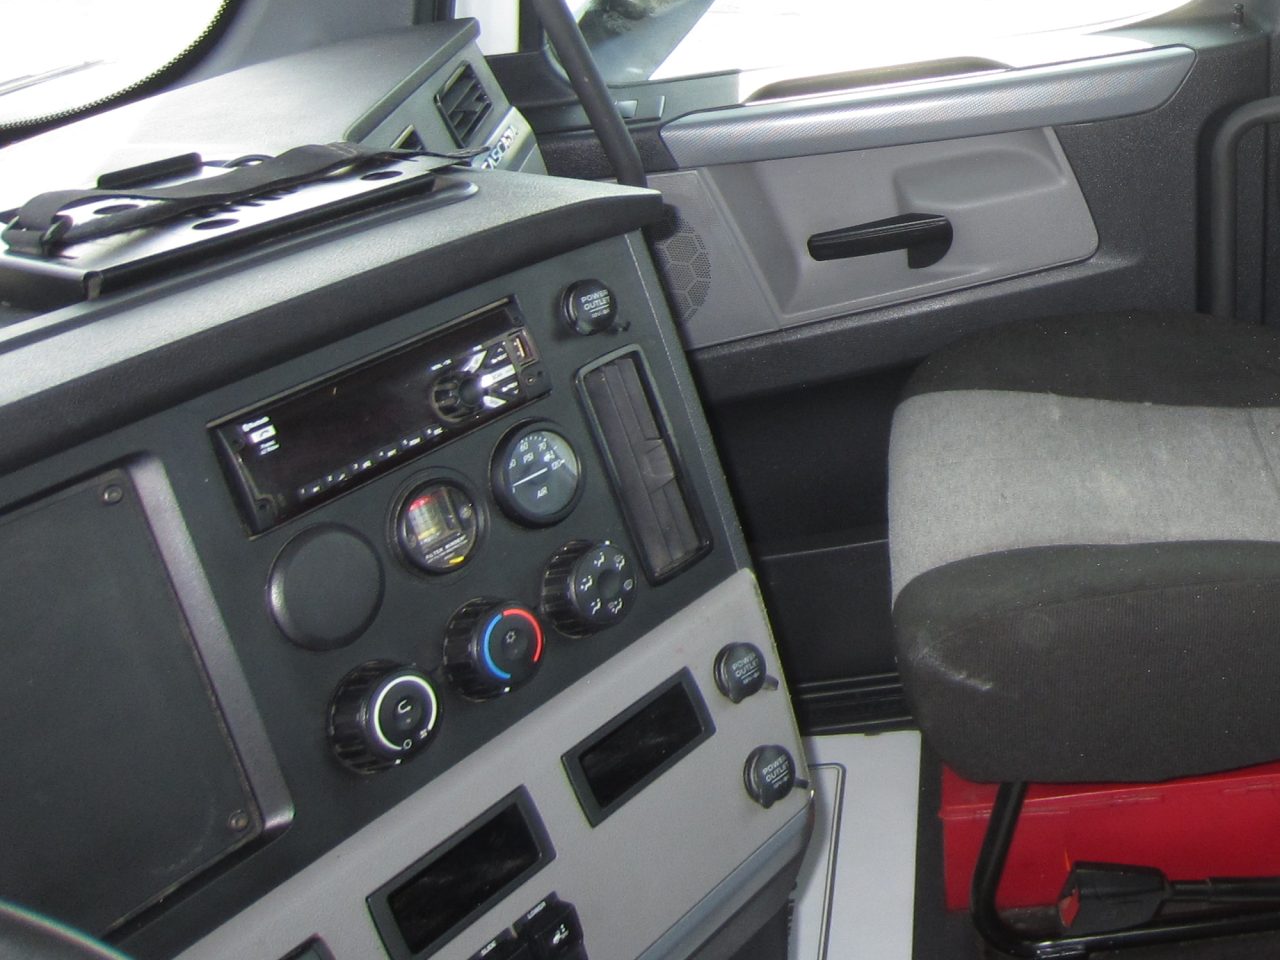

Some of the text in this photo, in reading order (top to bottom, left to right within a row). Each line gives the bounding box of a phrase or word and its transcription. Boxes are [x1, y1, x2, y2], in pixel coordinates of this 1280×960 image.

[581, 289, 609, 303] POWER
[583, 295, 610, 310] OUTLET
[735, 658, 760, 678] OUTLET
[765, 760, 790, 783] OUTLET
